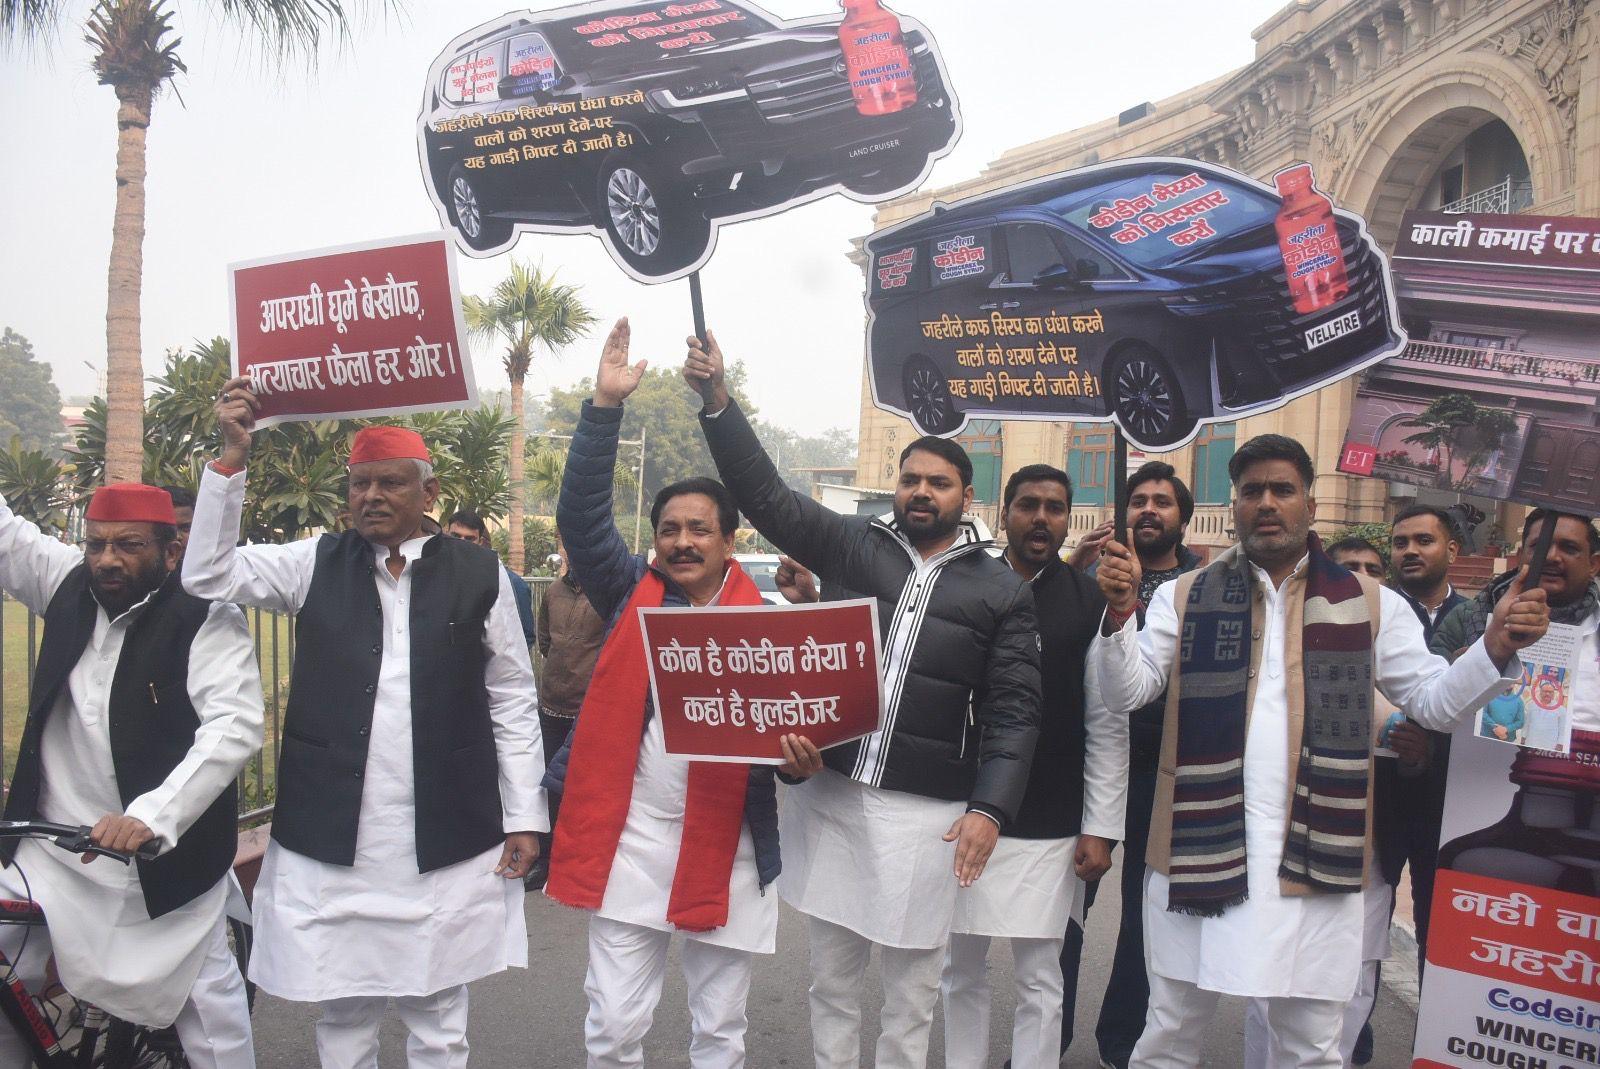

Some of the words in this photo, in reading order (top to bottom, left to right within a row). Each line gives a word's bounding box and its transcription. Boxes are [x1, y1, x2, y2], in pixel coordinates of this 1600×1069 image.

[588, 33, 630, 47] को
[884, 70, 911, 82] SYRUP
[435, 112, 484, 133] जहरीले
[487, 111, 516, 125] कफ
[518, 105, 554, 121] सिरप
[558, 101, 576, 114] का
[610, 89, 645, 106] करने
[474, 130, 505, 147] वालों
[508, 127, 527, 142] को
[531, 123, 565, 139] शरण
[569, 117, 591, 134] देने
[594, 116, 613, 129] पर
[463, 156, 486, 169] यह
[489, 148, 520, 165] गाड़ी
[522, 145, 559, 160] गिफ्ट
[562, 139, 578, 155] दी
[580, 133, 613, 152] जाती
[849, 147, 869, 158] LAND
[869, 139, 900, 153] CRUISER
[1087, 194, 1157, 228] कोडीन
[1110, 222, 1148, 244] को
[1138, 190, 1230, 233] गिरफ्तार
[938, 235, 975, 251] जहरीला
[1283, 234, 1338, 265] कोडीन
[1288, 223, 1326, 245] जहरीला
[1411, 220, 1475, 247] काली
[1478, 223, 1551, 255] कमाई
[1553, 231, 1589, 254] पर
[933, 246, 985, 267] कोडीन
[940, 269, 962, 279] COUGH
[963, 265, 985, 276] SYRUP
[945, 261, 978, 273] WINCEREX
[1292, 264, 1315, 278] COUGH
[1315, 256, 1337, 270] SYRUP
[1296, 253, 1329, 270] WINCEREX
[260, 282, 325, 333] अपराधी
[327, 278, 359, 334] घूमे
[920, 313, 964, 340] जहरीले
[964, 318, 990, 337] कफ
[991, 311, 1024, 336] सिरप
[1024, 317, 1043, 335] का
[1044, 309, 1070, 335] धंधा
[1071, 308, 1105, 334] करने
[1306, 313, 1359, 347] VELLFIRE
[246, 356, 326, 396] अत्याचार
[325, 343, 373, 388] फैला
[373, 348, 405, 385] हर
[956, 343, 985, 368] वालों
[986, 342, 1005, 366] को
[1006, 348, 1036, 366] शरण
[1037, 341, 1058, 366] देने
[1059, 346, 1078, 365] पर
[947, 379, 968, 398] यह
[968, 371, 998, 402] गाड़ी
[999, 371, 1032, 397] गिफ्ट
[1032, 370, 1047, 396] दी
[1048, 370, 1081, 396] जाती
[1346, 450, 1373, 467] ET
[658, 638, 703, 673] कौन
[705, 637, 724, 677] है
[726, 637, 795, 674] कोडीन
[800, 635, 847, 673] भैया
[683, 688, 725, 726] कहां
[729, 688, 746, 727] है
[749, 691, 841, 734] बुलडोजर
[1452, 888, 1541, 927] नही
[1447, 1036, 1547, 1069] COUGH
